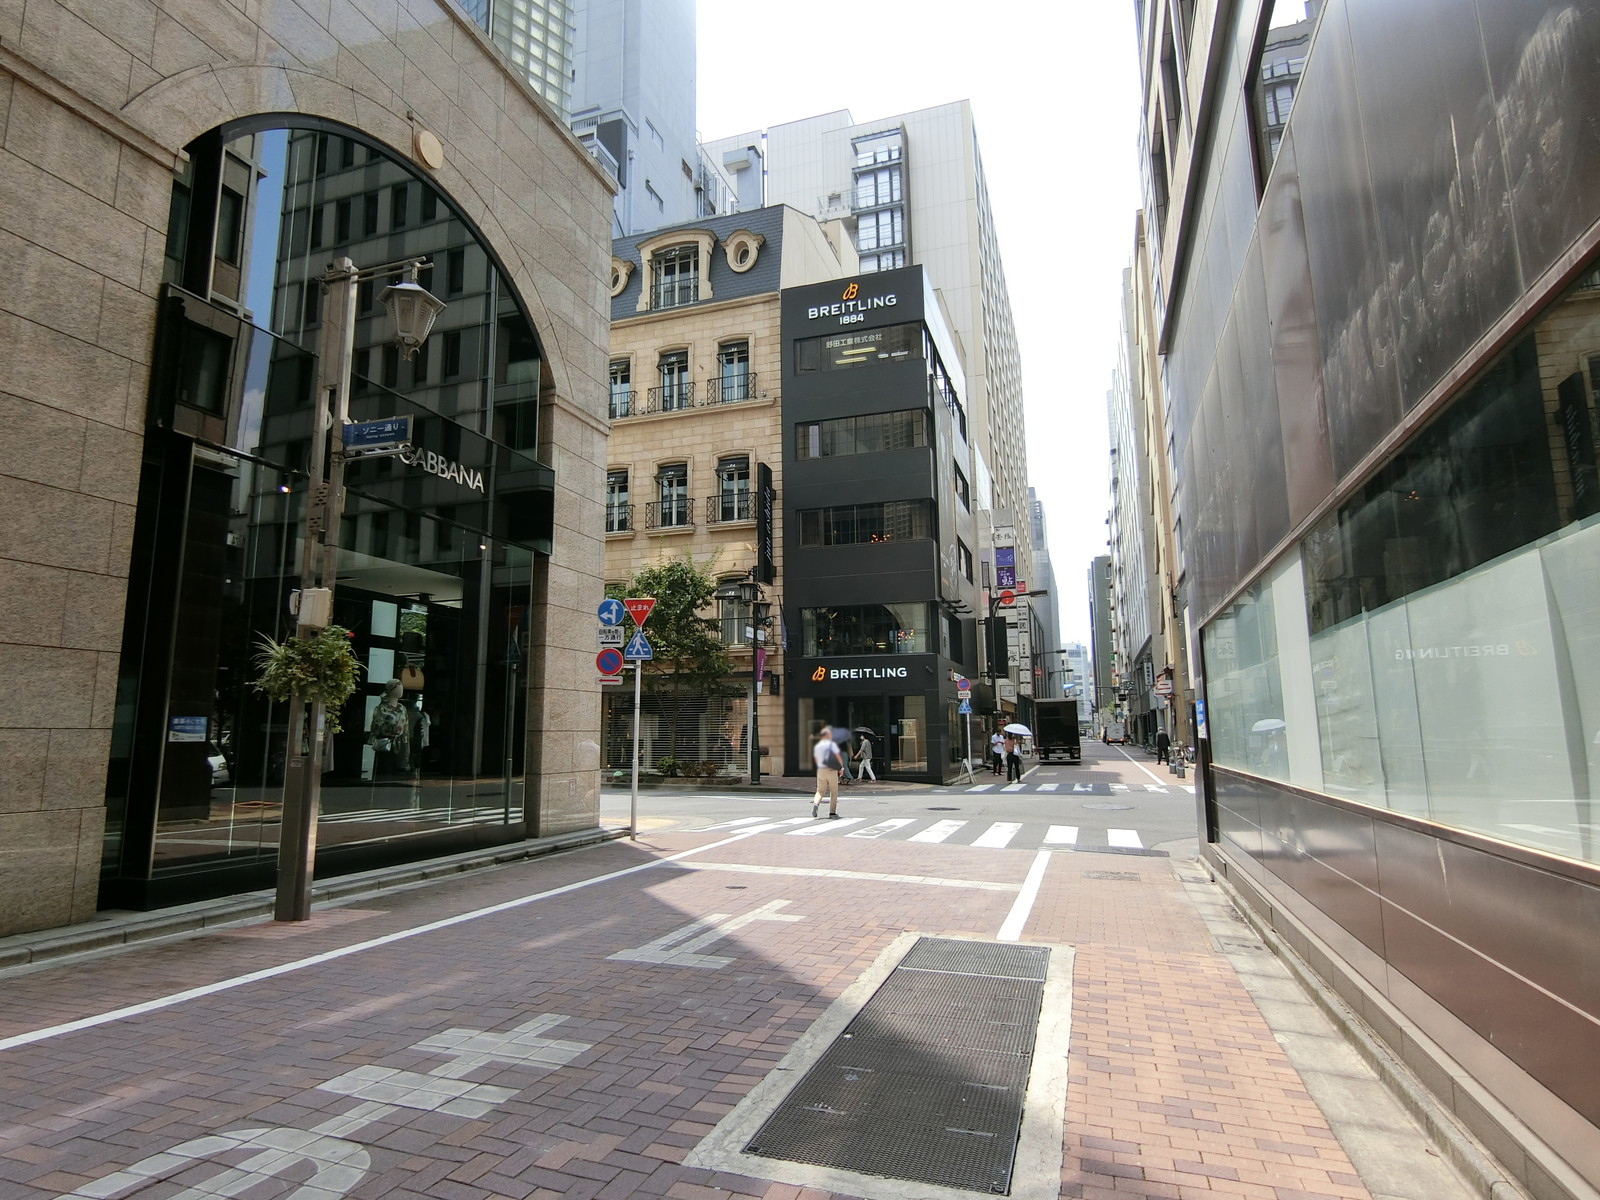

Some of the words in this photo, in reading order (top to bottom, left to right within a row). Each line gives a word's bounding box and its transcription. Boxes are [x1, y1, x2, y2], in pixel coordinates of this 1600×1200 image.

[808, 294, 897, 319] BREITLING
[839, 313, 865, 325] 1884
[363, 422, 399, 434] ソニー通り
[830, 667, 908, 679] BREITLING
